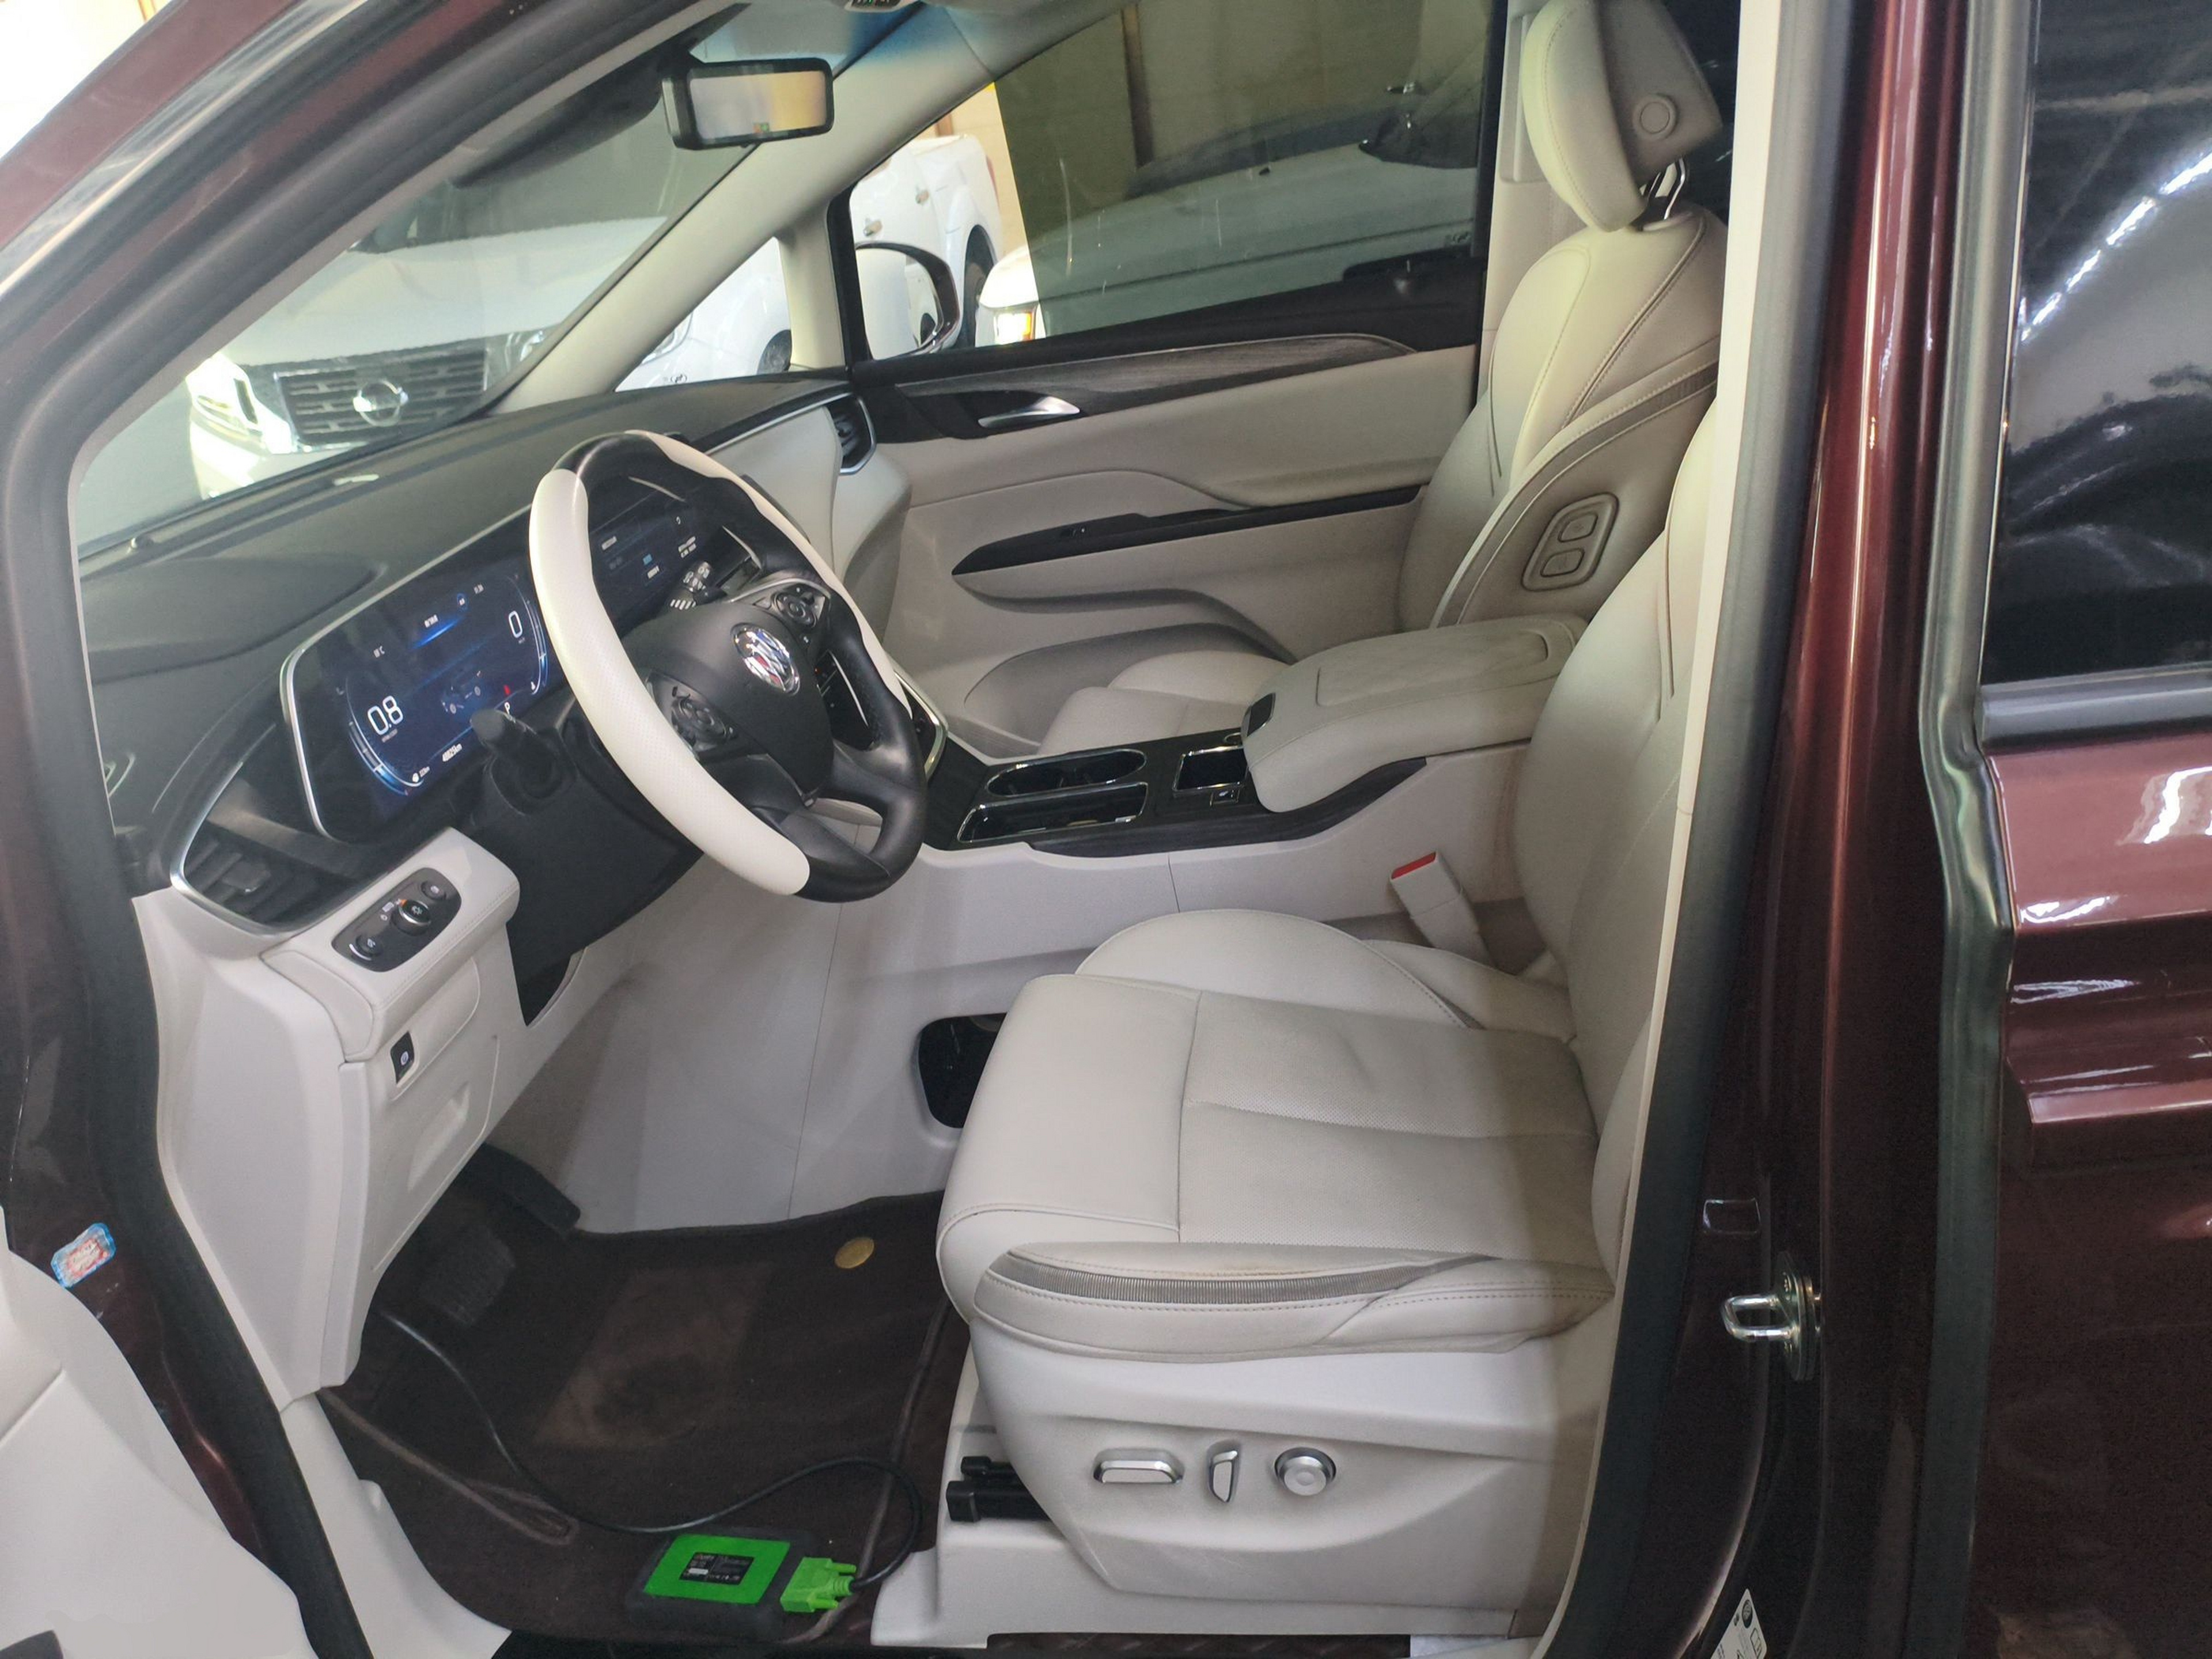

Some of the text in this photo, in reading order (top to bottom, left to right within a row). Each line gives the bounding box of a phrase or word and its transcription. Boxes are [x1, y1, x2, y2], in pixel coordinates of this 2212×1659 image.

[508, 611, 523, 638] 0
[368, 695, 403, 735] 0.8
[504, 701, 510, 715] P
